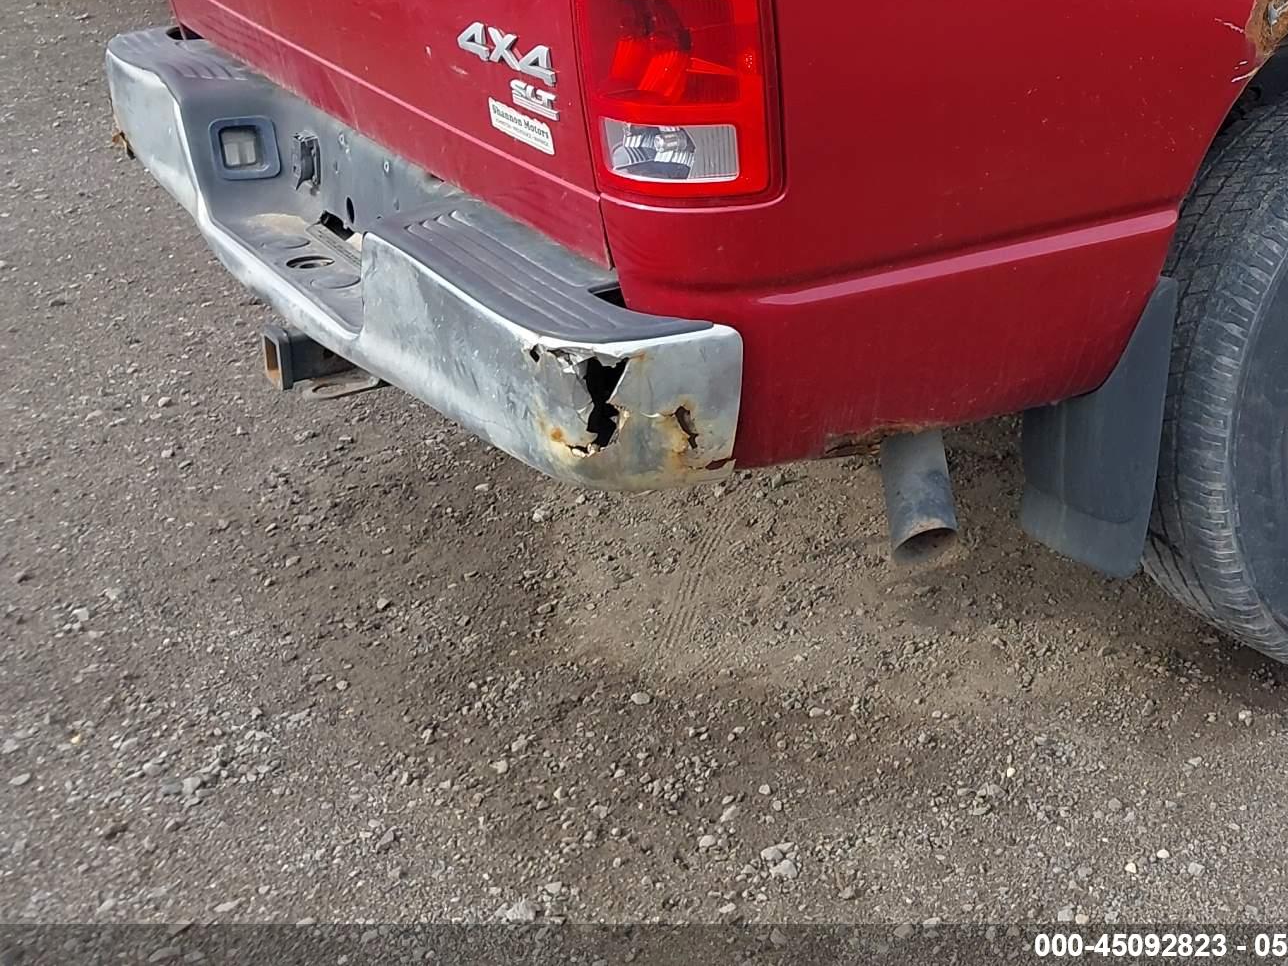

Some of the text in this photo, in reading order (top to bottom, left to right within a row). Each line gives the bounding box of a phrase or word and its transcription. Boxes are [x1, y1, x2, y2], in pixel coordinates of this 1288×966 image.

[510, 79, 557, 110] SLT
[491, 104, 523, 127] Shannon
[523, 118, 550, 140] Motors
